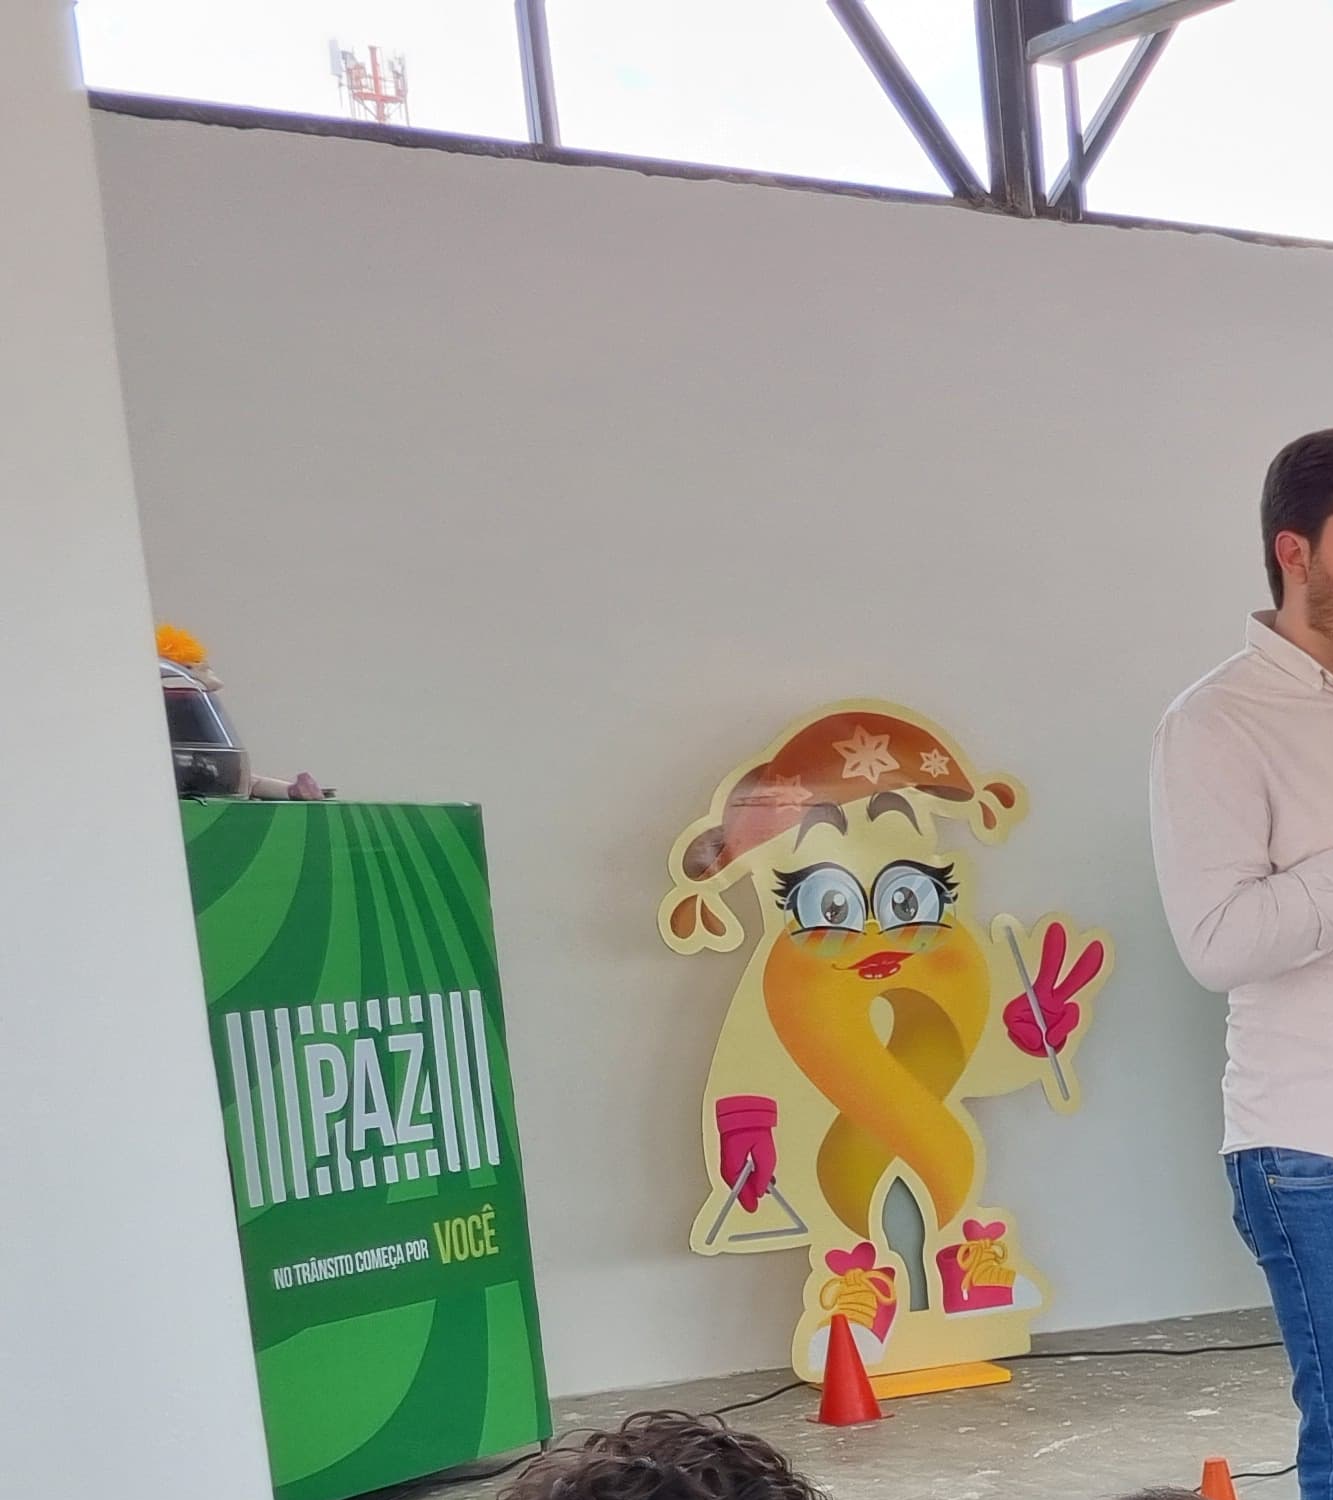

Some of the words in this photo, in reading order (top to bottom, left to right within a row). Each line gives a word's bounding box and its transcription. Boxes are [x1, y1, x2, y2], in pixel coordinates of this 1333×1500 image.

[304, 1032, 434, 1158] PAZ
[273, 1266, 293, 1290] NO
[293, 1254, 354, 1285] TRÂNSITO
[355, 1245, 405, 1273] COMEÇA
[406, 1239, 429, 1263] POR
[433, 1203, 499, 1264] VOCÊ
